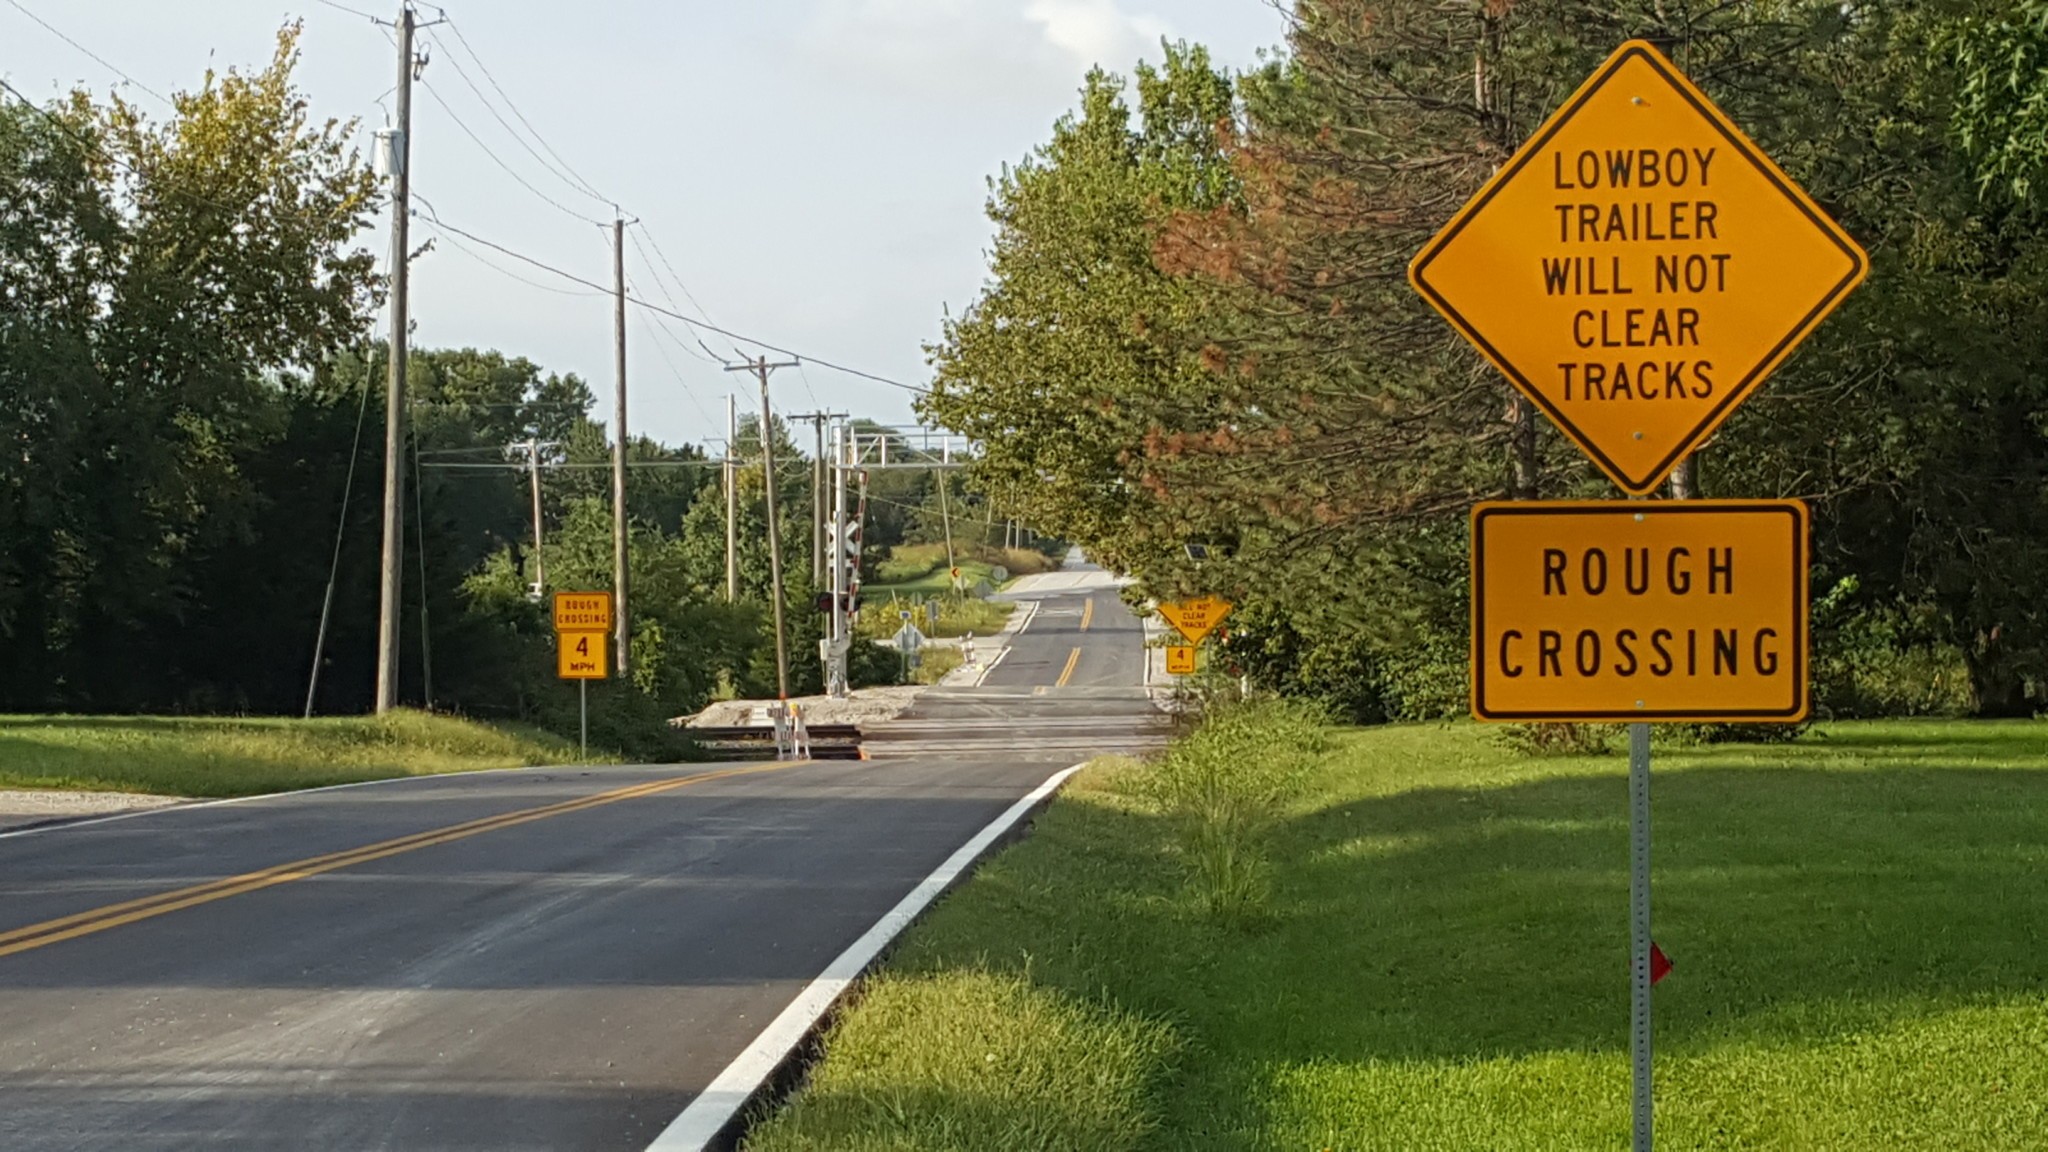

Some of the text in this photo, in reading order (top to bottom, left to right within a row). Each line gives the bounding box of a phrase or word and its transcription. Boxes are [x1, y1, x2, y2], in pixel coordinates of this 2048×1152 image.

[1555, 148, 1716, 189] LOWBOY
[1555, 202, 1718, 242] TRAILER
[1541, 254, 1731, 295] WILL NOT
[1573, 309, 1700, 348] CLEAR
[1557, 361, 1713, 401] TRACKS
[1543, 547, 1733, 596] ROUGH
[558, 614, 607, 624] CROSSING
[565, 600, 600, 610] ROUGH
[576, 636, 588, 657] 4
[1177, 649, 1184, 660] 4
[1499, 628, 1778, 677] CROSSING
[570, 662, 595, 671] MPH
